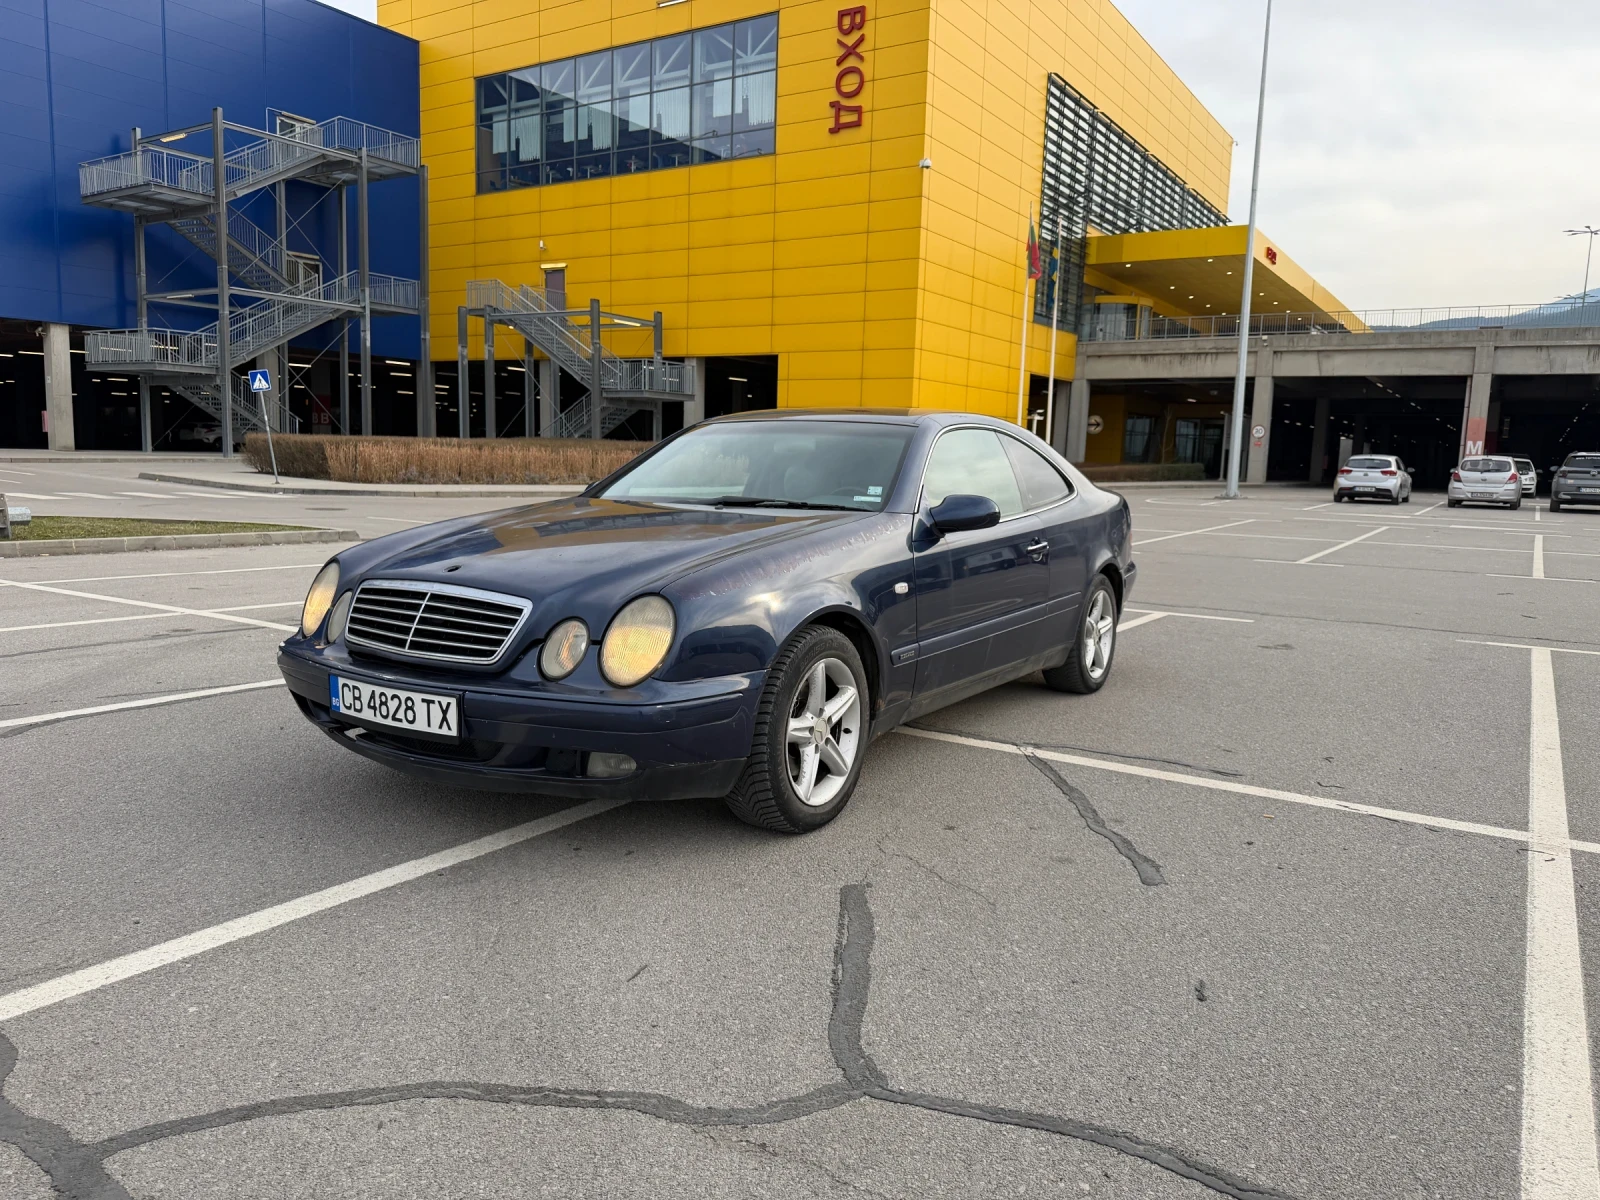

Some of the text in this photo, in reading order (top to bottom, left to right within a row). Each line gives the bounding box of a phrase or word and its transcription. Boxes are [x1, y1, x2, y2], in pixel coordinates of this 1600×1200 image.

[828, 5, 866, 134] ВХОД
[1466, 440, 1482, 455] M
[332, 697, 340, 707] BG
[341, 682, 453, 731] CB 4828 TX
